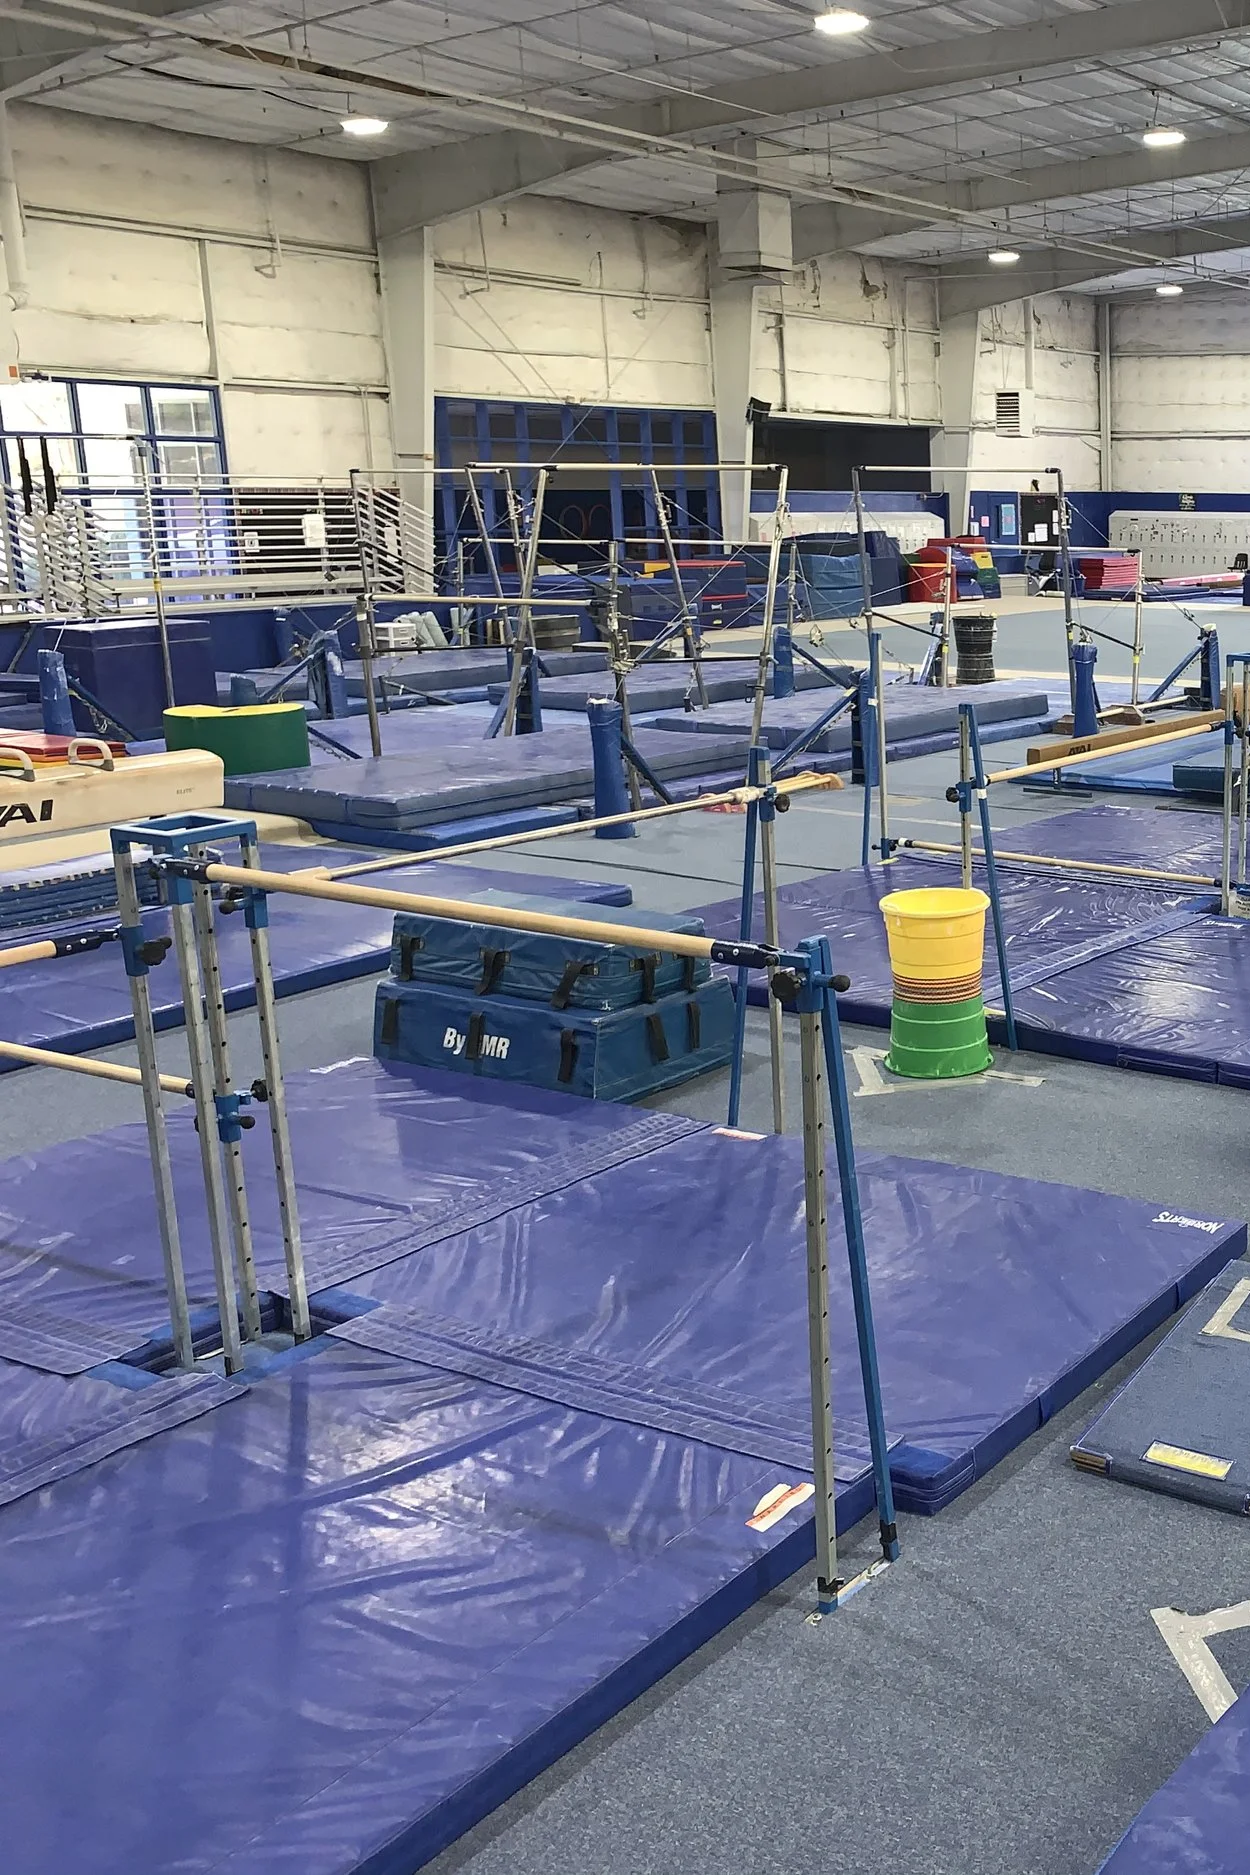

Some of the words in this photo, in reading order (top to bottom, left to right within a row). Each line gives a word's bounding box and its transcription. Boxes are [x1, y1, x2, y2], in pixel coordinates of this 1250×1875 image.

[0, 799, 53, 827] AI
[443, 1027, 466, 1055] By
[479, 1034, 510, 1059] MR
